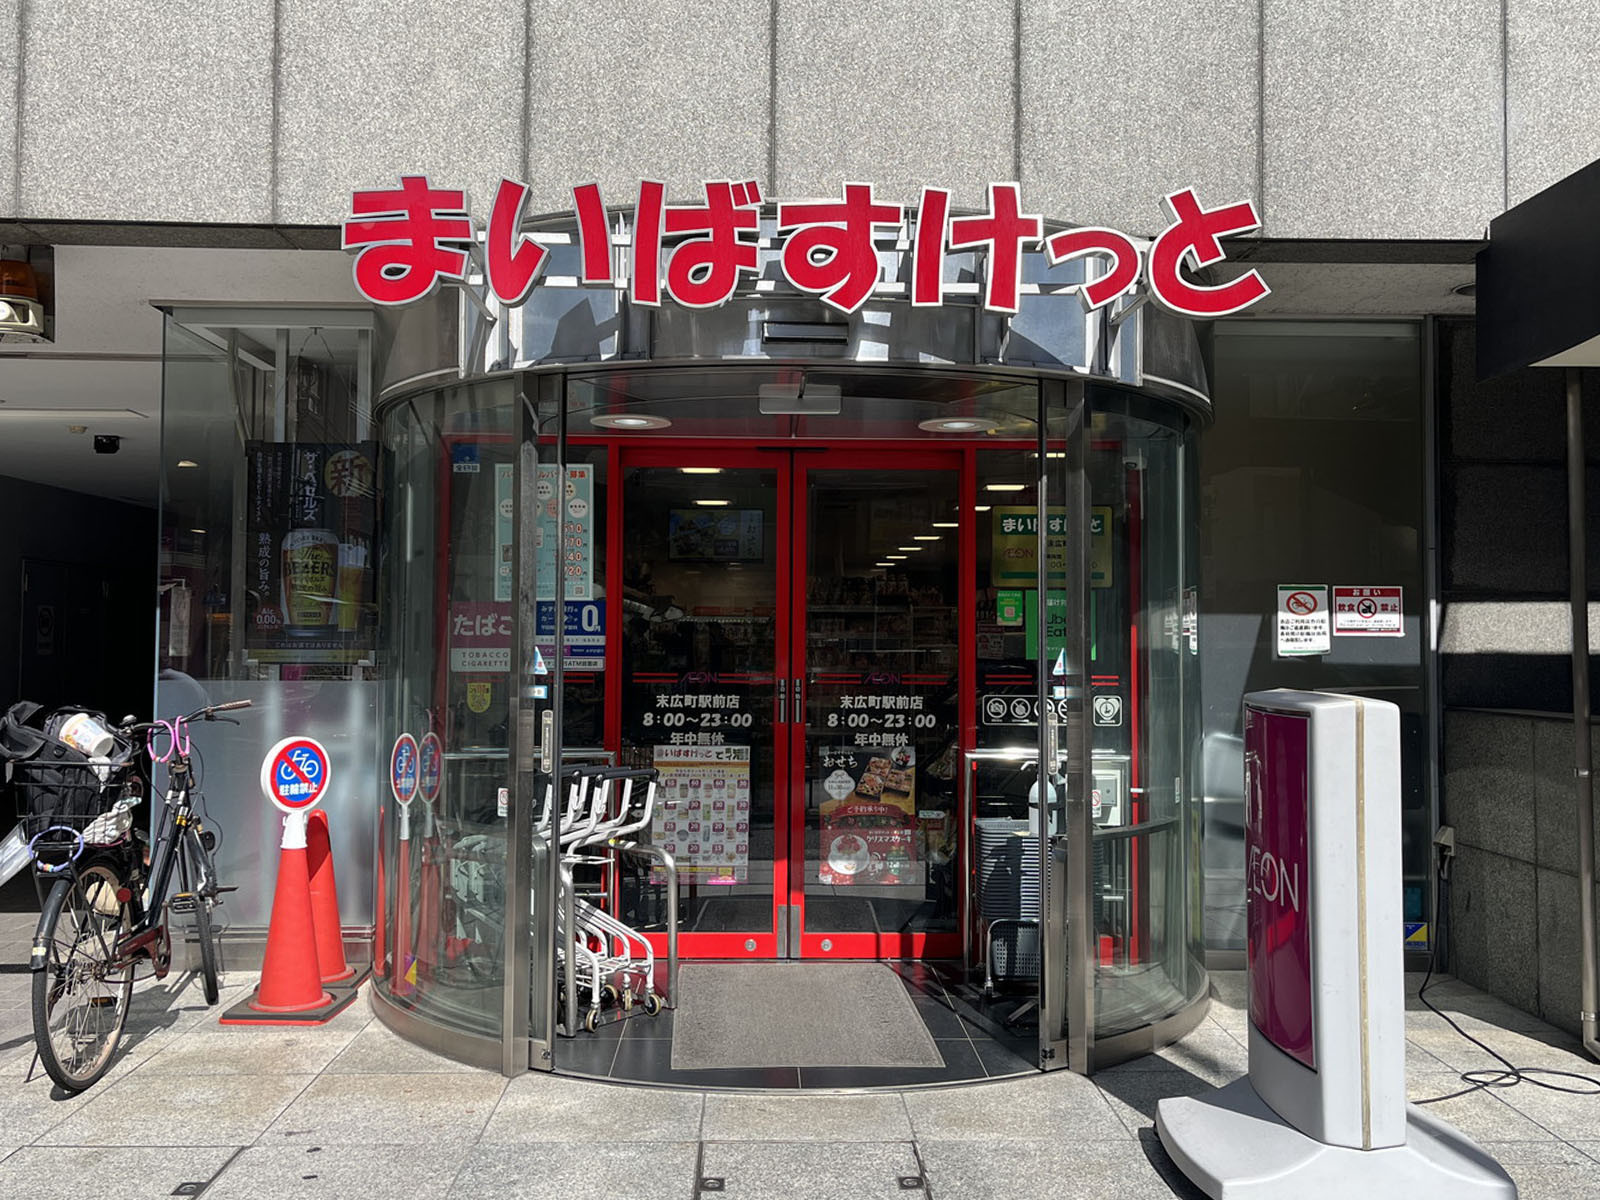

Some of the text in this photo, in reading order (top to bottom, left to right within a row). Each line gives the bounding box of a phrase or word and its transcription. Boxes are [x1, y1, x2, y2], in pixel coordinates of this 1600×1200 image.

[341, 175, 1272, 317] まいばすけっと
[454, 613, 512, 637] たばこ
[656, 694, 740, 709] 末広町駅前店
[840, 695, 924, 710] 末広町駅前店
[670, 731, 725, 746] 年中無休
[854, 732, 909, 747] 年中無休
[823, 755, 858, 769] おせち
[279, 782, 318, 796] 駐輪禁止
